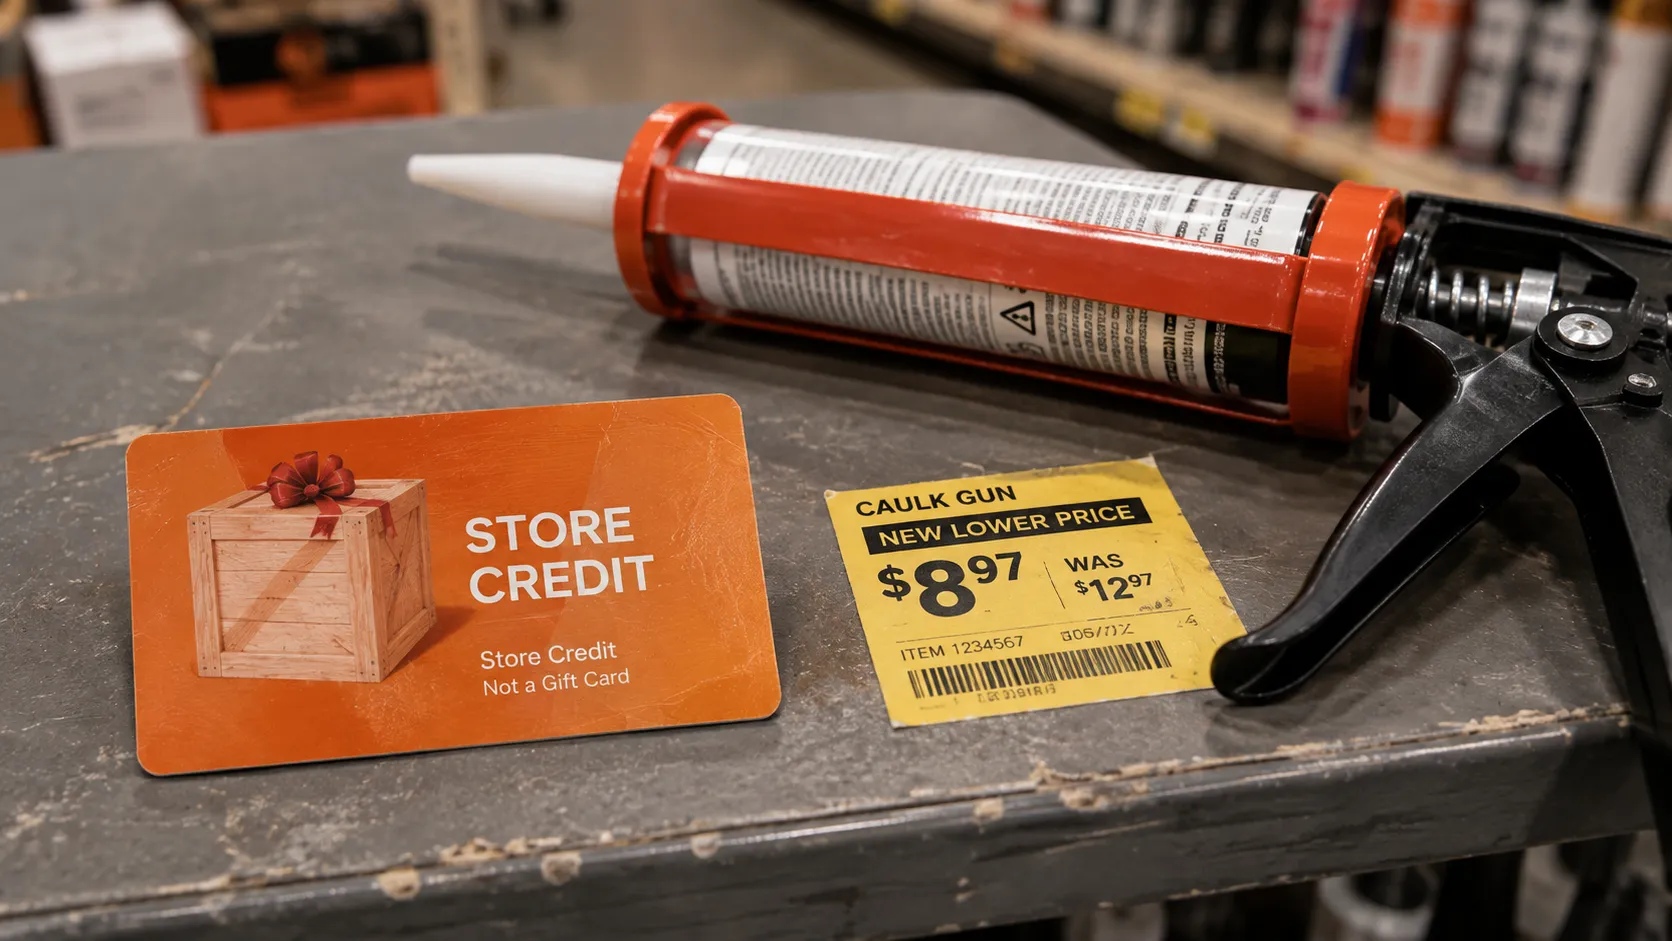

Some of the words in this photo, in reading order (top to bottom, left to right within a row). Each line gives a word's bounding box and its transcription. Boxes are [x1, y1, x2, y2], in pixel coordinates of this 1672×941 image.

[856, 493, 951, 517] CAULK
[956, 485, 1017, 506] GUN
[465, 506, 635, 554] STORE
[878, 525, 941, 547] NEW
[951, 514, 1050, 539] LOWER
[1057, 504, 1136, 527] PRICE
[1064, 553, 1124, 573] WAS
[469, 554, 654, 604] CREDIT
[480, 650, 541, 670] Store
[548, 640, 618, 664] Credit
[900, 645, 946, 662] ITEM
[952, 635, 1024, 655] 1234567
[483, 679, 519, 696] Not
[525, 680, 536, 694] a
[542, 673, 578, 692] Gift
[584, 668, 630, 688] Card
